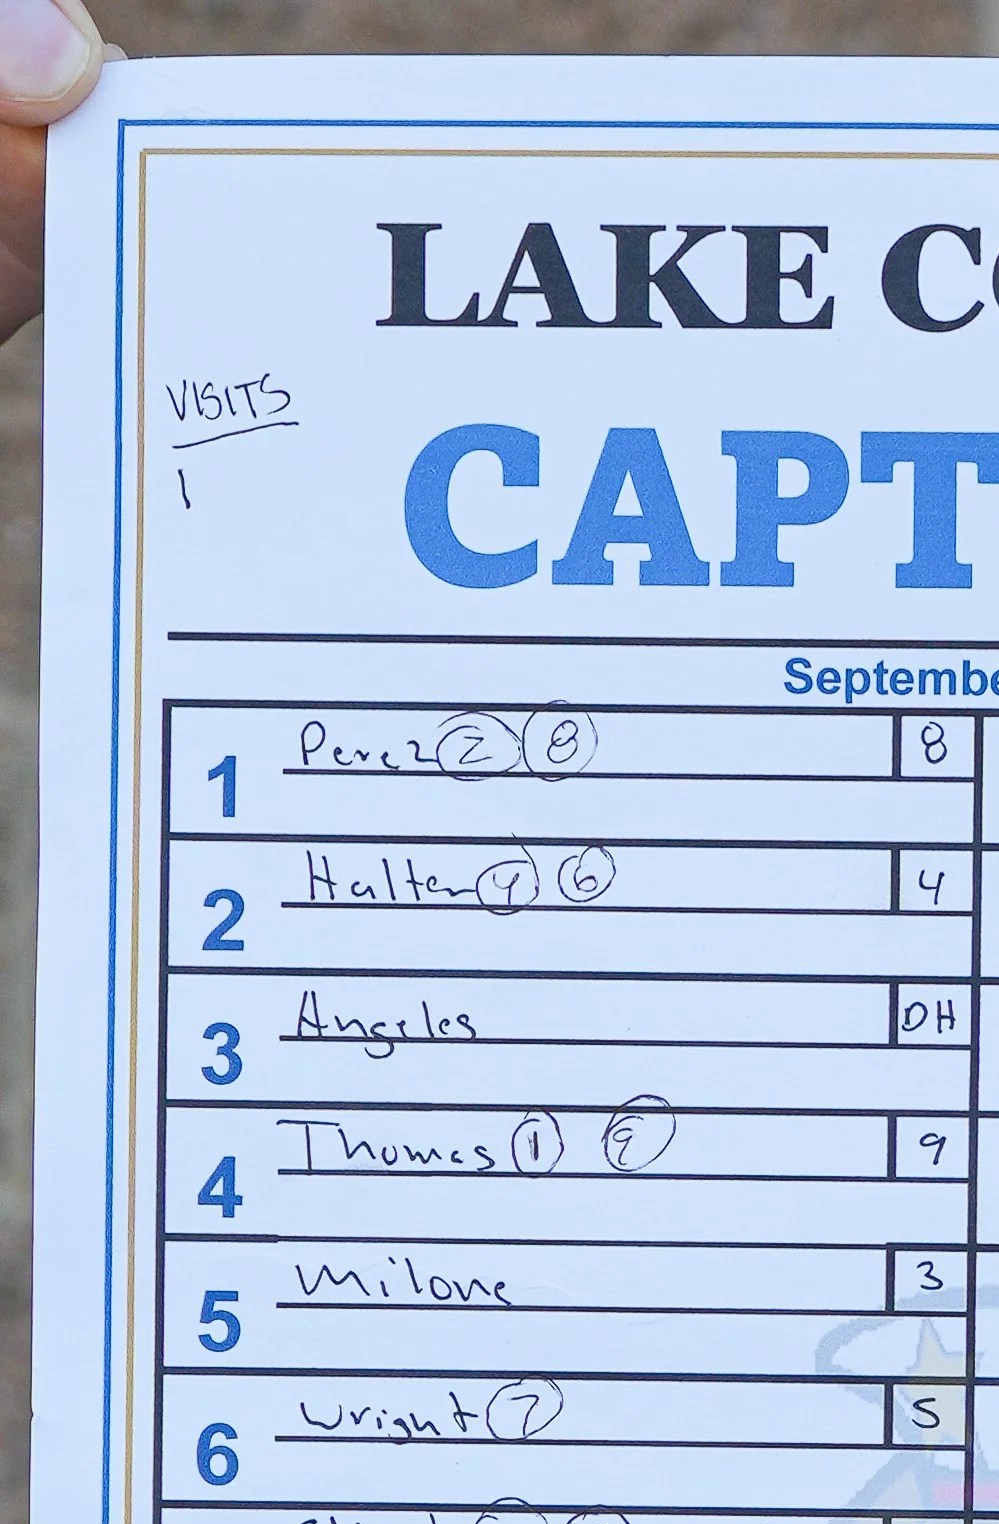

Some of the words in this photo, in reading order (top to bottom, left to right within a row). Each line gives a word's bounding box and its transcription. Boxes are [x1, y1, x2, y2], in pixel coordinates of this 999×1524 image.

[375, 222, 835, 330] LAKE
[165, 373, 291, 421] VISITS
[301, 721, 438, 770] Perez
[923, 721, 947, 764] 8
[207, 755, 237, 818] 1
[918, 870, 944, 906] 4
[201, 888, 245, 952] 2
[297, 991, 477, 1059] Angeles
[901, 1000, 956, 1030] DH
[201, 1022, 243, 1086] 3
[277, 1120, 496, 1175] Thomas
[920, 1134, 946, 1164] 9
[197, 1155, 244, 1219] 4
[918, 1263, 943, 1290] 3
[198, 1290, 241, 1353] 5
[912, 1398, 941, 1426] 5
[196, 1422, 239, 1486] 6
